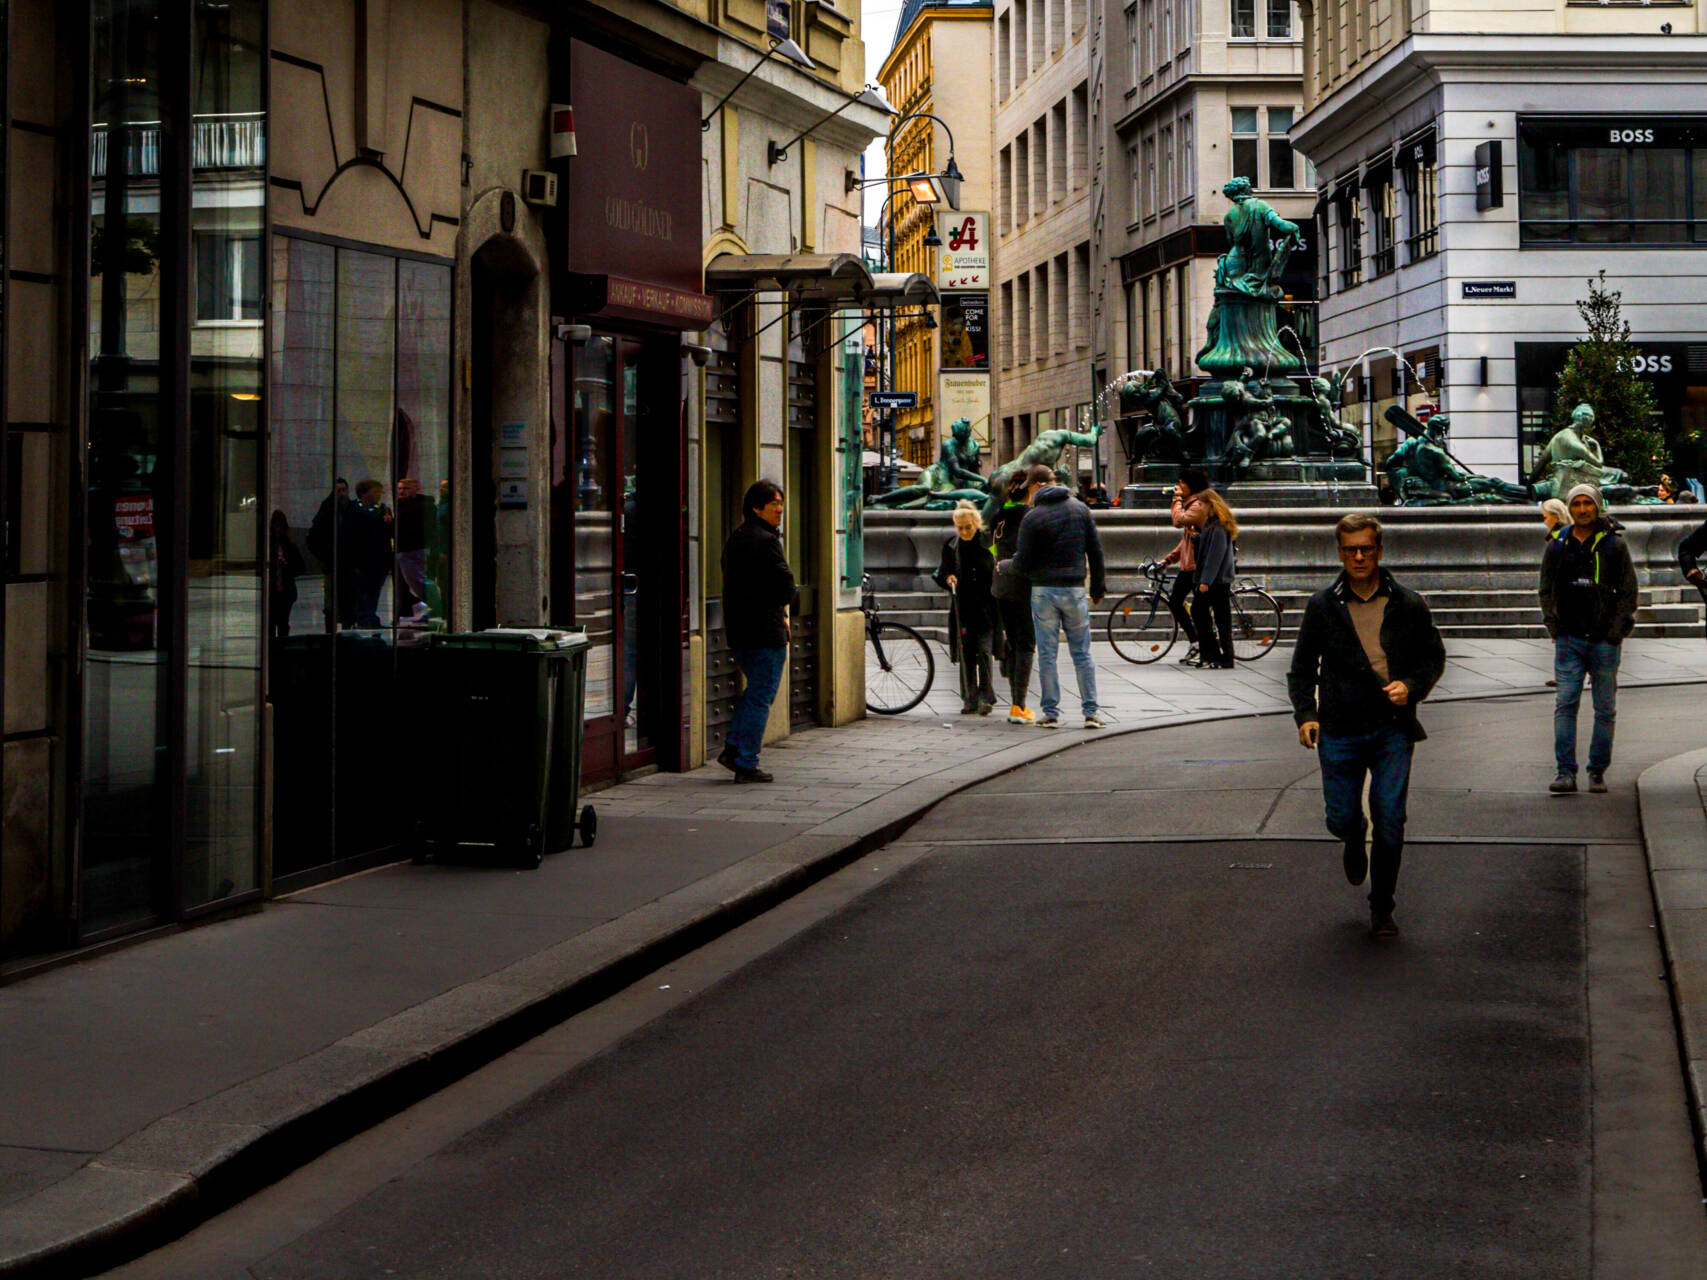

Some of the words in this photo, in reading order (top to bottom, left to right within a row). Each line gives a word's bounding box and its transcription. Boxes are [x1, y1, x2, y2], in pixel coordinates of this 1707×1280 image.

[1610, 129, 1654, 143] BOSS
[1476, 166, 1490, 185] BOSS
[1472, 285, 1493, 293] Neuer
[1493, 285, 1514, 293] Markt
